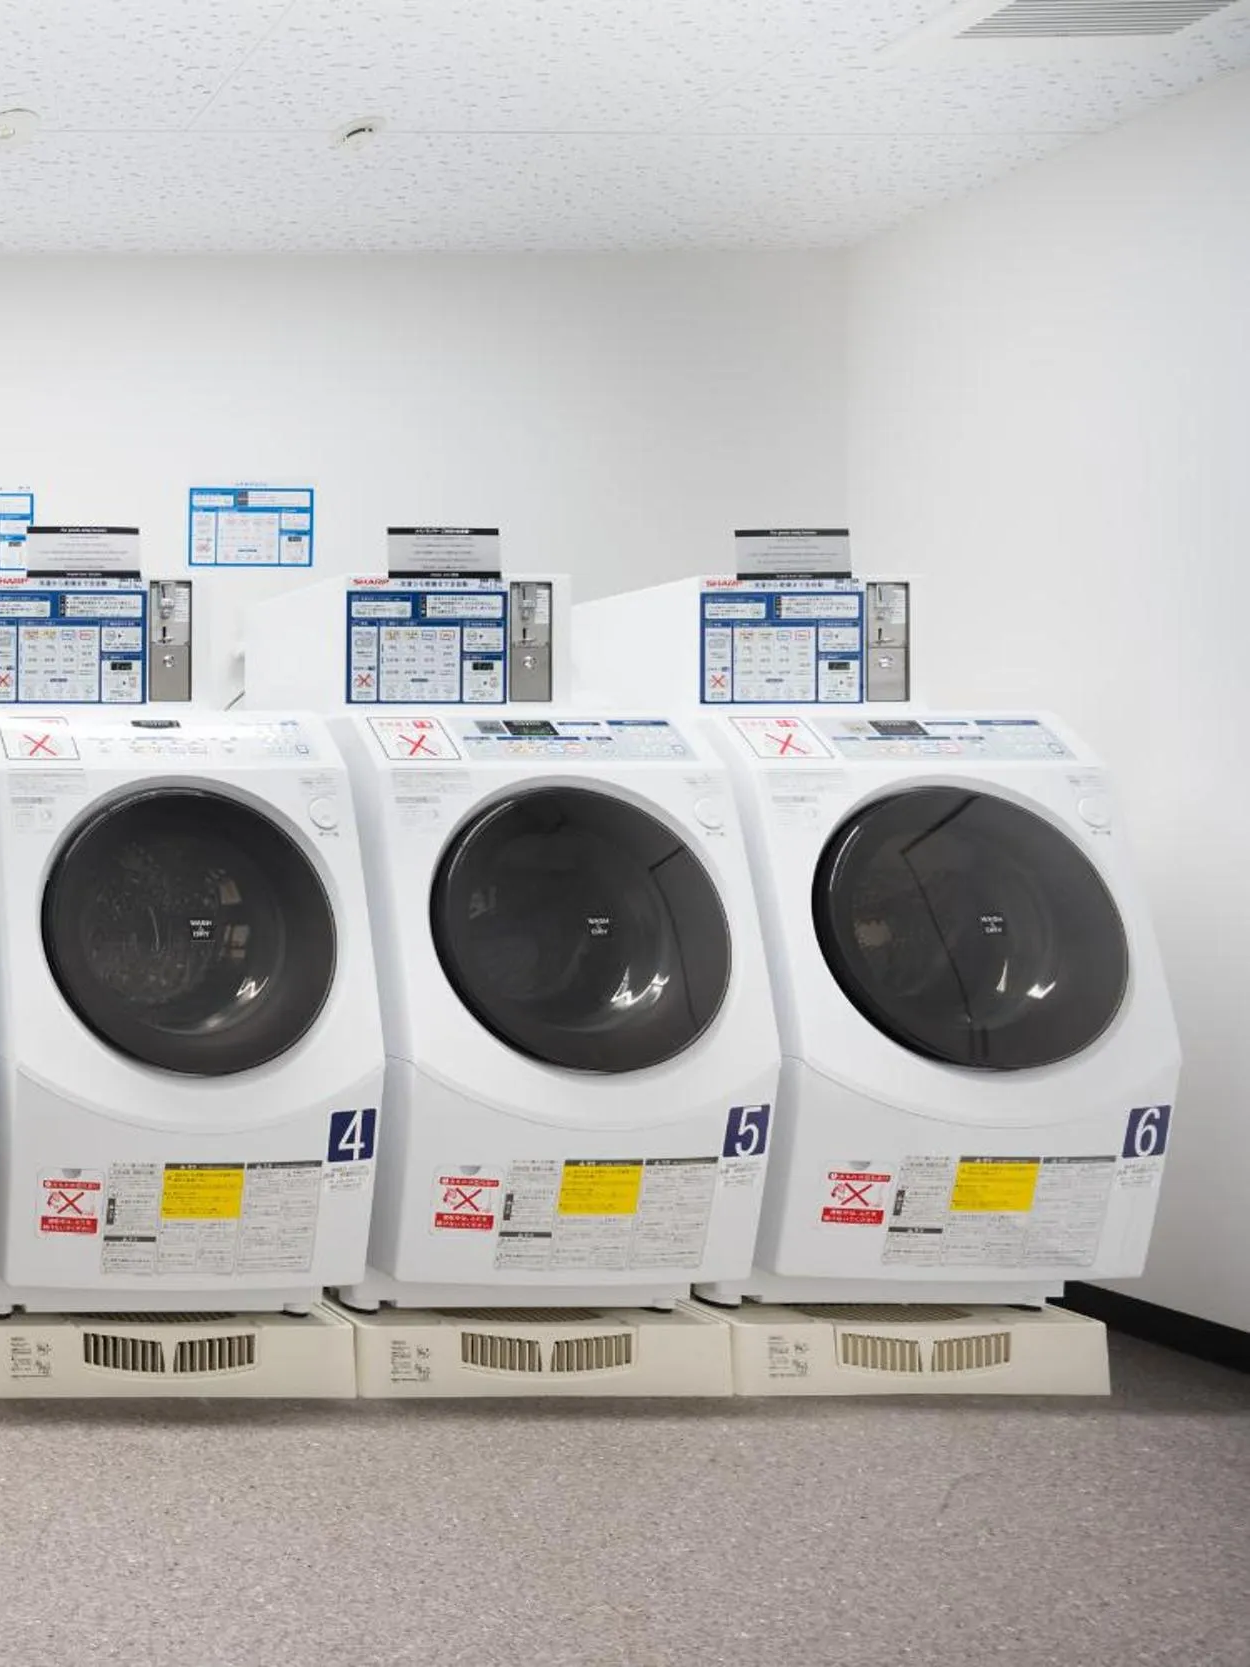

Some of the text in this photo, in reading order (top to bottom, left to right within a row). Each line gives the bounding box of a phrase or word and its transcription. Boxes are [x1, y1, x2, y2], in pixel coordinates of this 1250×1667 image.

[353, 578, 390, 586] SHARP
[706, 579, 743, 587] SHARP
[337, 1110, 365, 1161] 4
[734, 1106, 763, 1157] 5
[1134, 1107, 1161, 1157] 6
